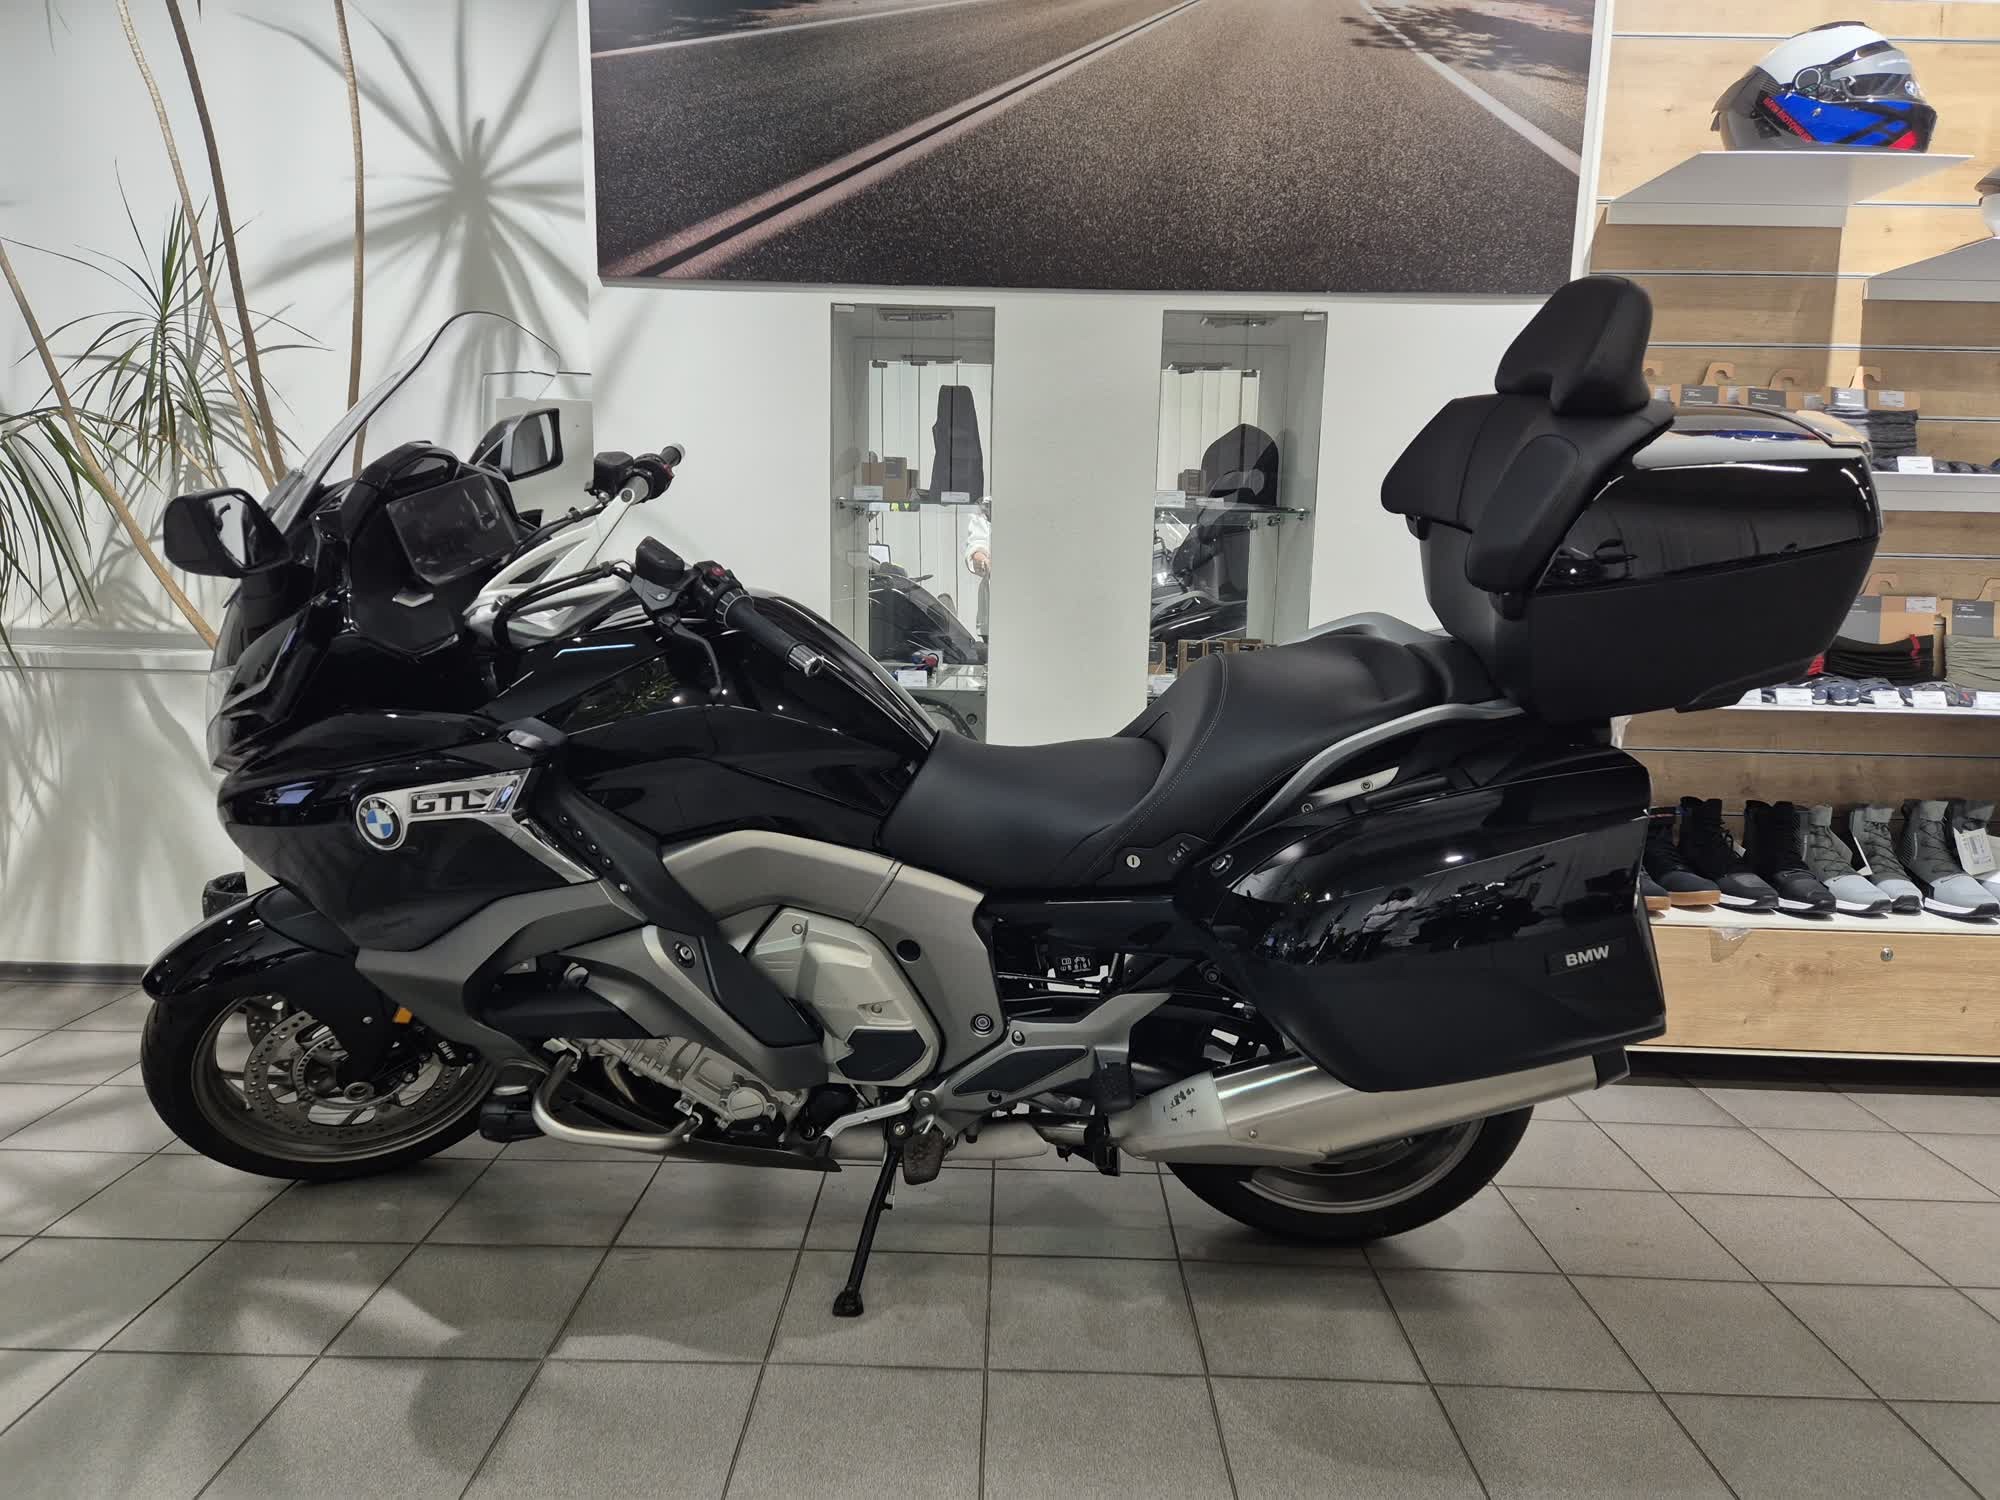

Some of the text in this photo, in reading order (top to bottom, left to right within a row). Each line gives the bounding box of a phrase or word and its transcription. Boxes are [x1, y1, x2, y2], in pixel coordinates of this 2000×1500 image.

[411, 791, 489, 813] GTL
[1565, 945, 1609, 967] BMW
[438, 1040, 456, 1060] BMW
